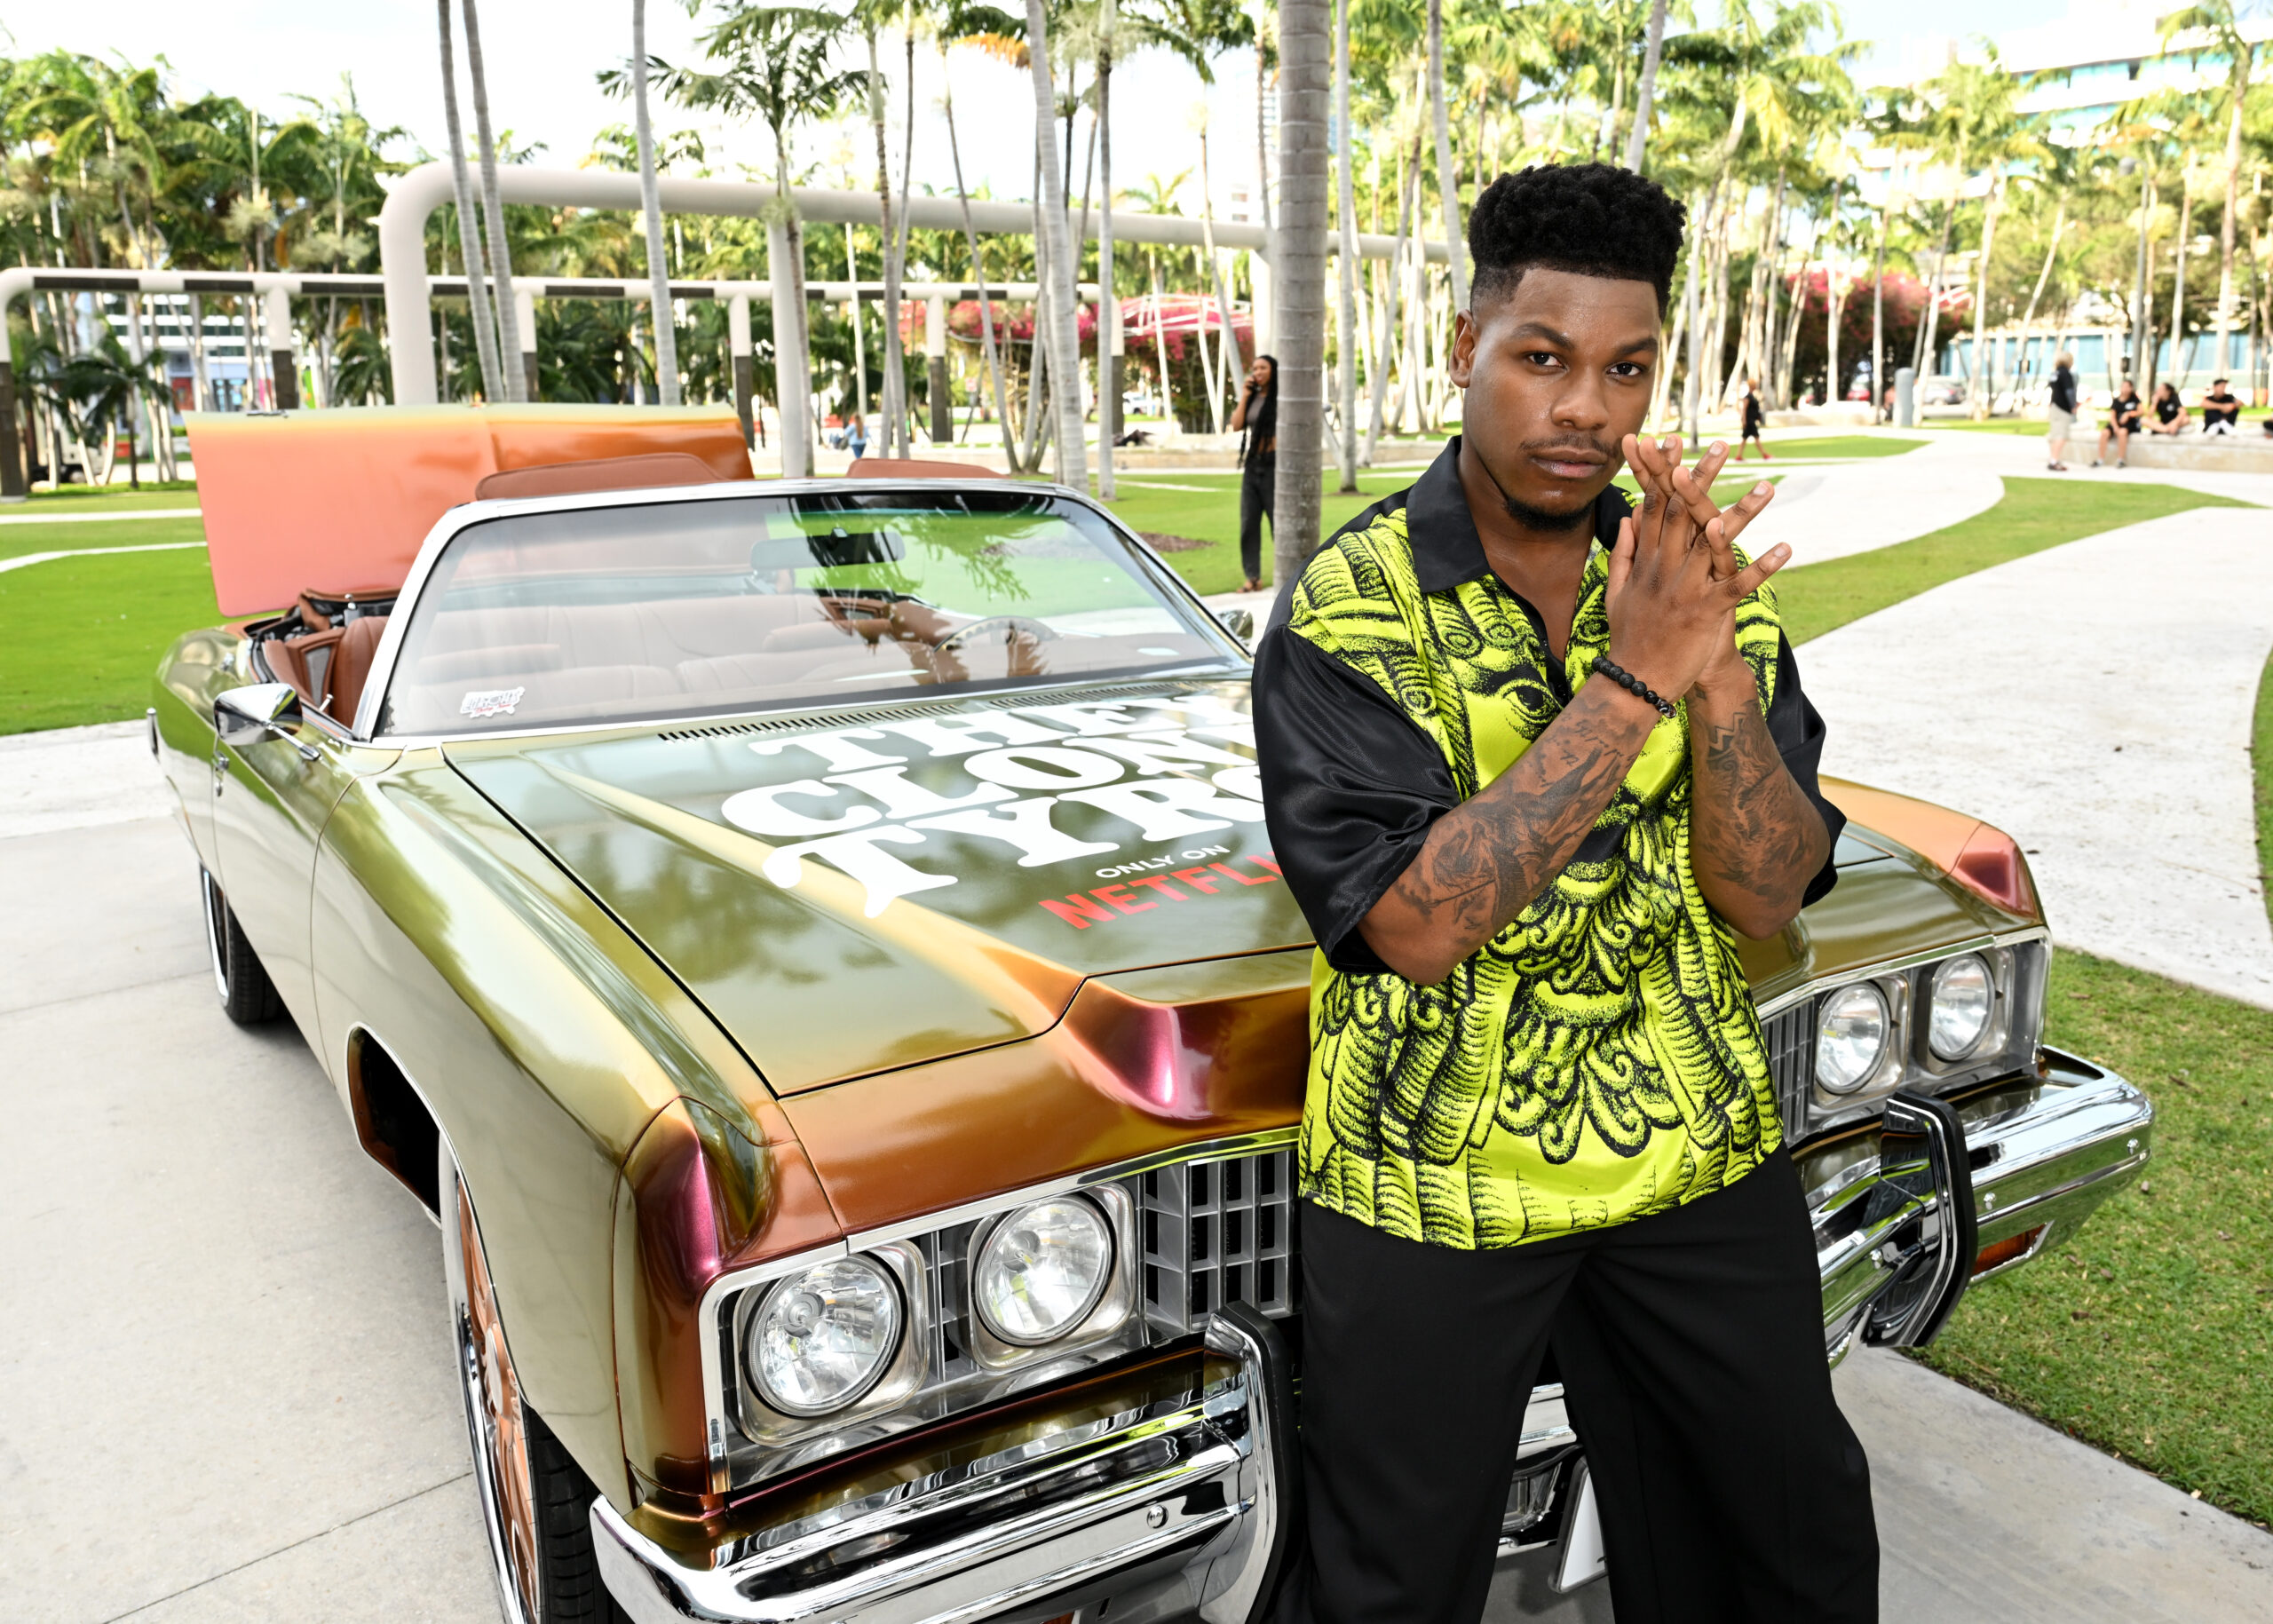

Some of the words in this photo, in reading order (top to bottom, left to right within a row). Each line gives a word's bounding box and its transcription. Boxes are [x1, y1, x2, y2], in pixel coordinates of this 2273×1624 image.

[748, 695, 1254, 772] THEY
[1038, 851, 1283, 930] NETFLI
[1096, 854, 1175, 878] ONLY
[1181, 844, 1231, 860] ON
